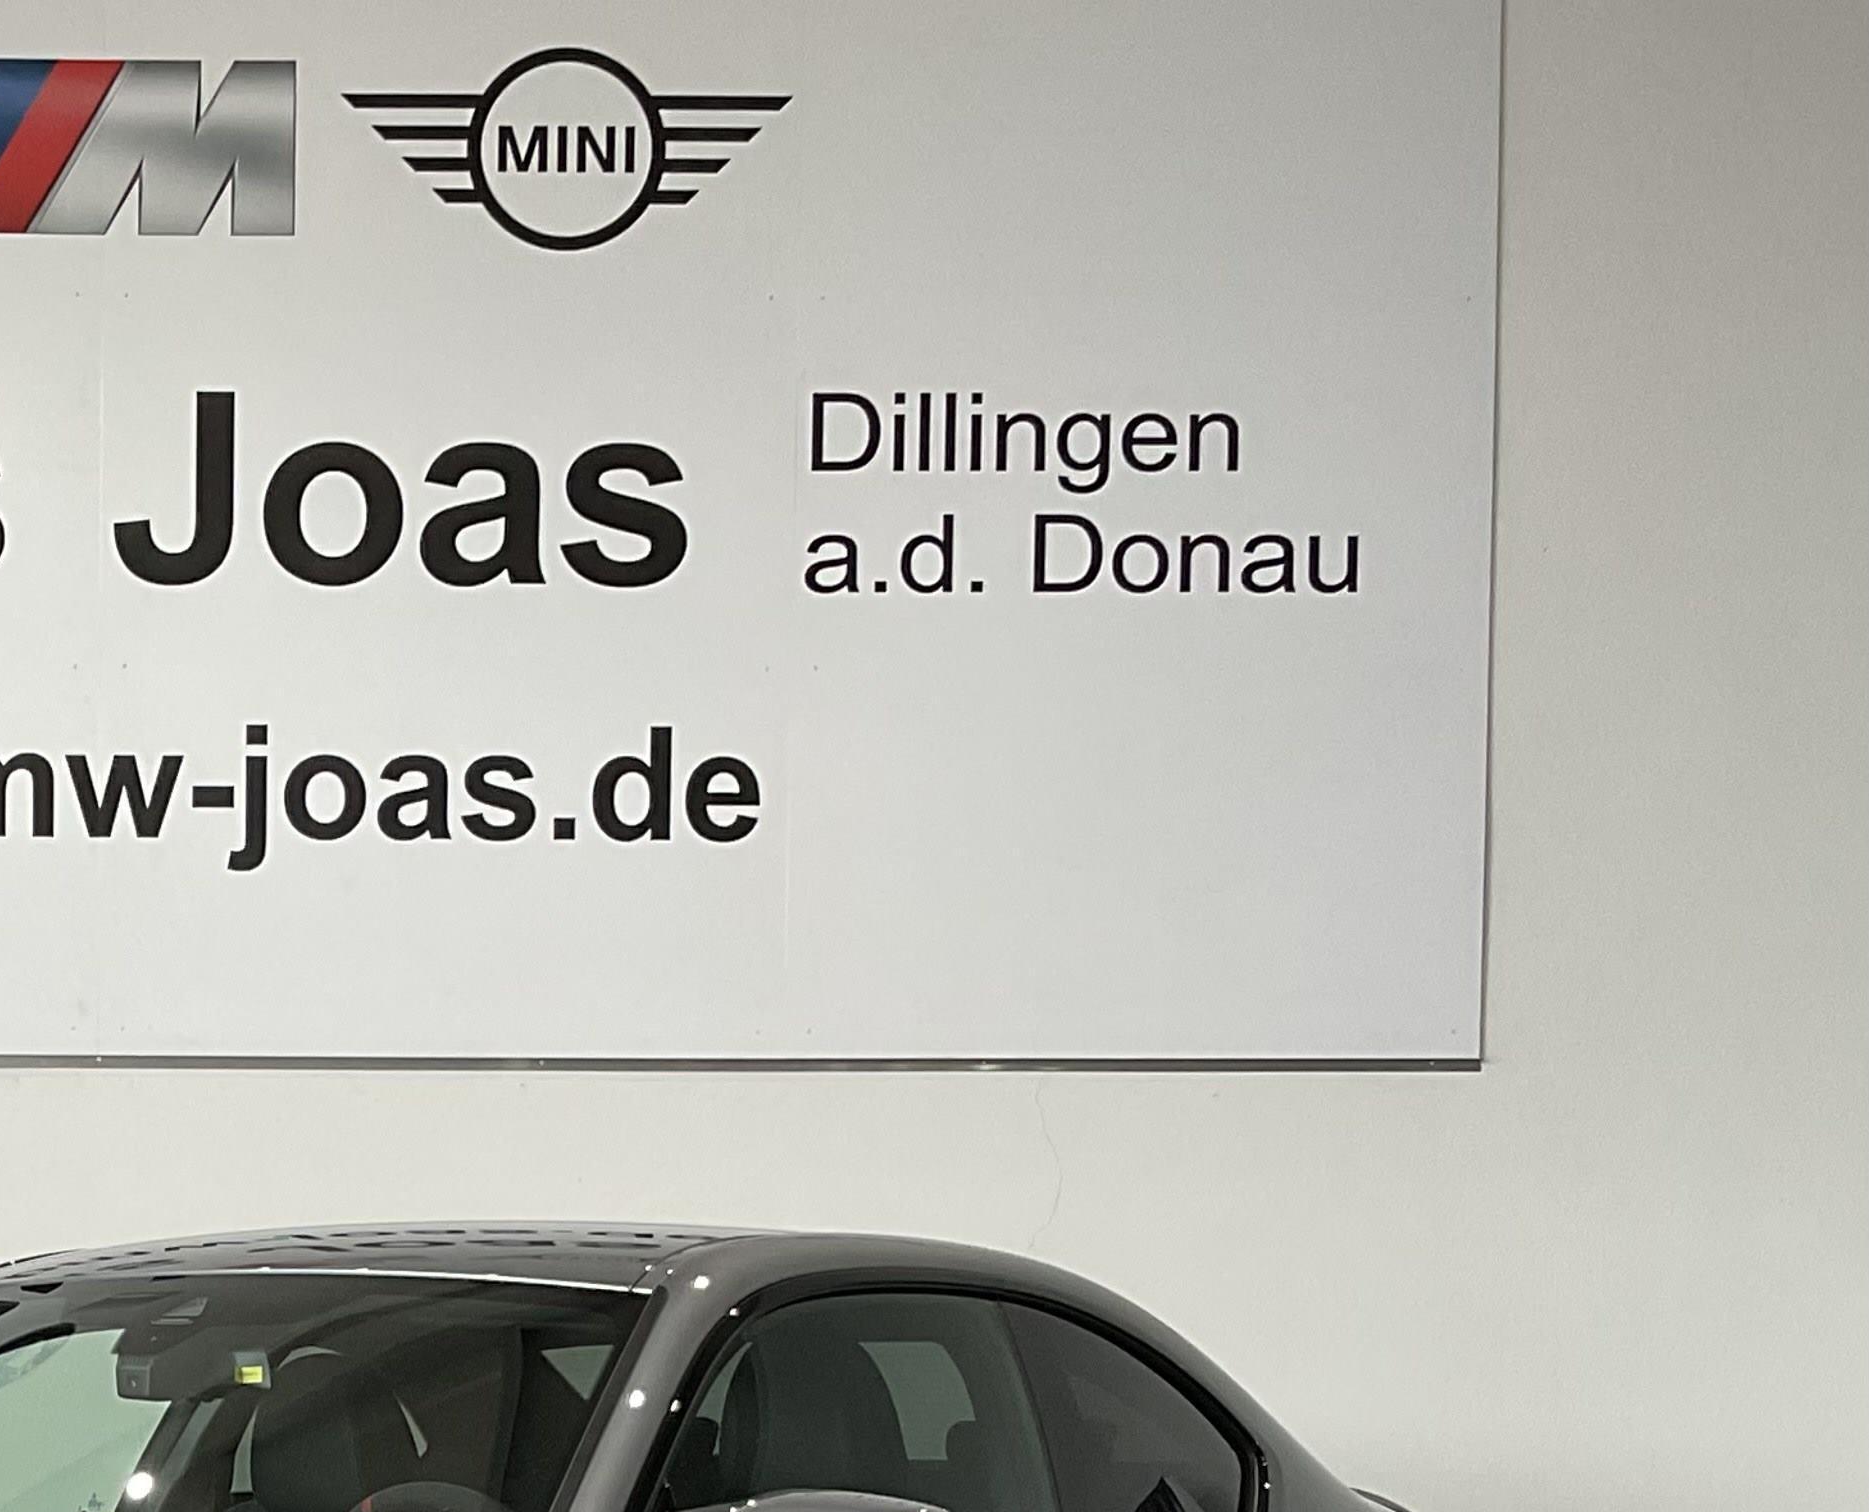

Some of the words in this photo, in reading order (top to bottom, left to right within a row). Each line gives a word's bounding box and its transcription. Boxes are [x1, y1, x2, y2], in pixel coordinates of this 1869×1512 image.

[30, 58, 297, 237] M
[497, 124, 637, 175] MINI
[113, 391, 688, 588] Joas
[810, 391, 1240, 495] Dillingen
[803, 513, 985, 595] a.d.
[1032, 513, 1360, 595] Donau
